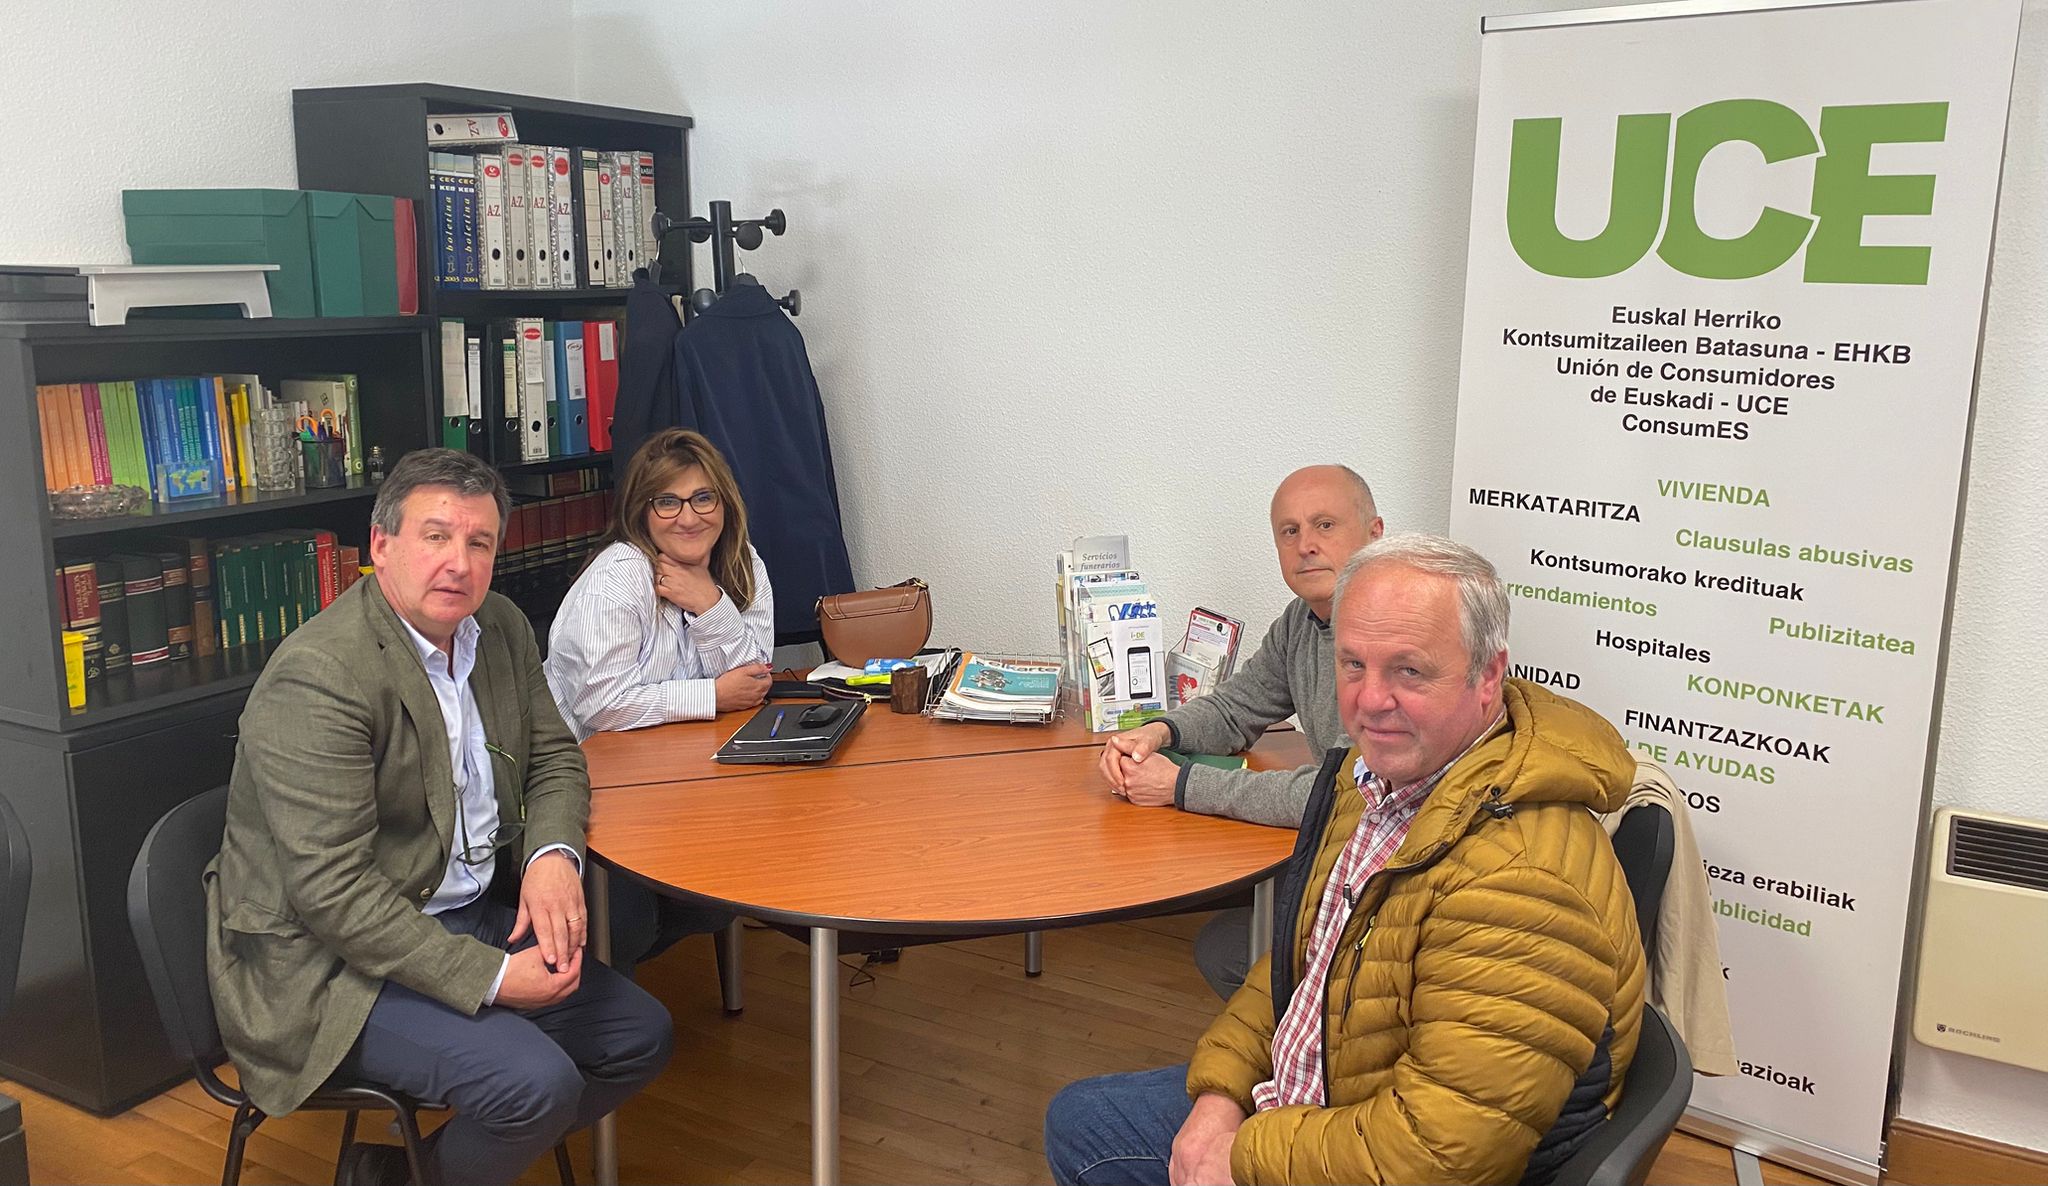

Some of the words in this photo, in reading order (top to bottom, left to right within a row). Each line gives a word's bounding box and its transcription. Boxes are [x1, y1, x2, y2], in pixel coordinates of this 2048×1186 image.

[1506, 99, 1950, 286] UCE
[1612, 306, 1687, 326] Euskal
[1694, 308, 1781, 330] Herriko
[1503, 328, 1688, 354] Kontsumitzaileen
[1695, 336, 1809, 360] Batasuna
[1833, 342, 1911, 364] EHKB
[1557, 356, 1619, 377] Unión
[1626, 360, 1653, 379] de
[1660, 362, 1835, 390] Consumidores
[1590, 385, 1617, 404] de
[1624, 387, 1714, 410] Euskadi
[1737, 394, 1789, 416] UCE
[1622, 413, 1749, 441] ConsumES
[1469, 488, 1641, 523] MERKATARITZA
[1657, 478, 1770, 507] VIVIENDA
[1081, 562, 1120, 572] funerarios
[1082, 552, 1118, 561] Servicios
[1676, 528, 1790, 559] Clausulas
[1799, 546, 1913, 573] abusivas
[1530, 548, 1687, 585] Kontsumorako
[1694, 570, 1804, 602] kredituak
[1507, 583, 1657, 617] rrendamientos
[1596, 629, 1711, 664] Hospitales
[1769, 618, 1916, 656] Publizitatea
[1686, 673, 1884, 724] KONPONKETAK
[1624, 709, 1831, 764] FINANTZAZKOAK
[1674, 751, 1775, 785] AYUDAS
[1752, 876, 1856, 912] erabiliak
[1736, 1059, 1816, 1096] azioak
